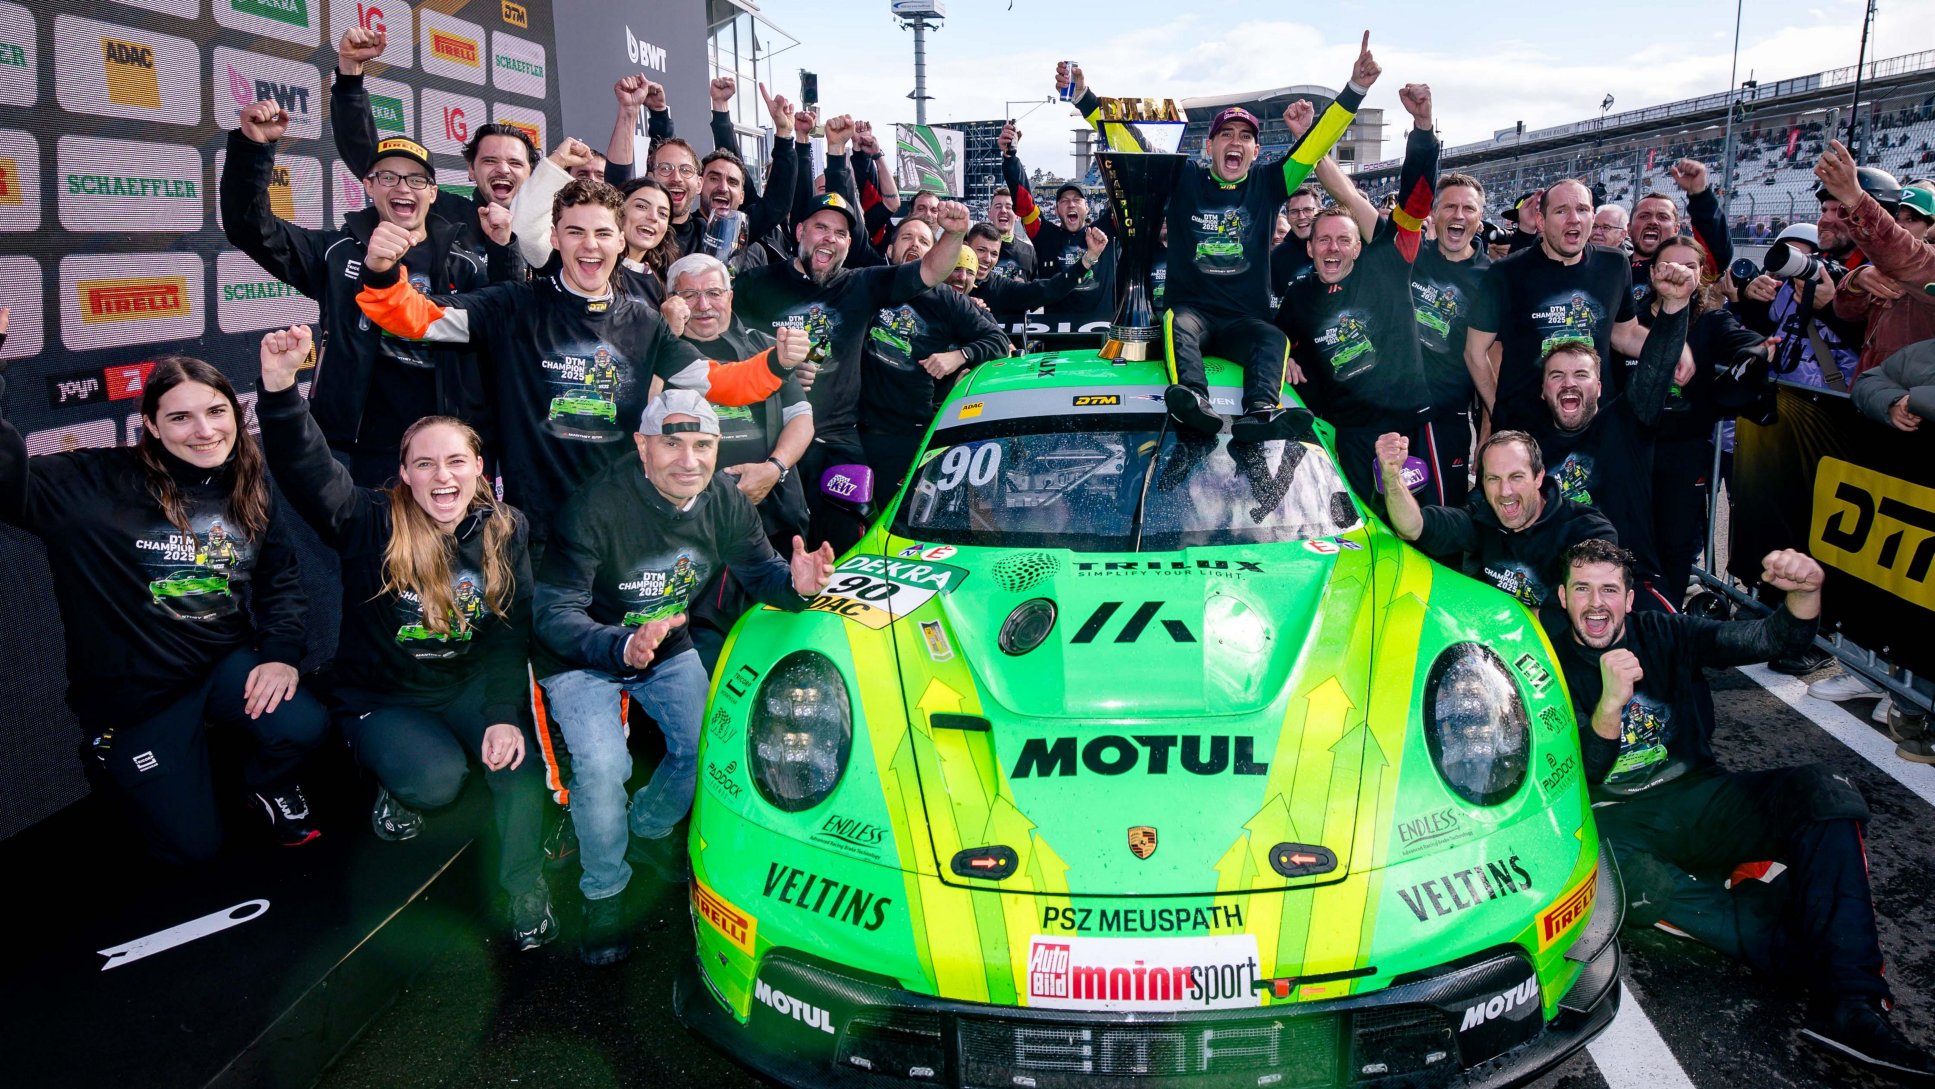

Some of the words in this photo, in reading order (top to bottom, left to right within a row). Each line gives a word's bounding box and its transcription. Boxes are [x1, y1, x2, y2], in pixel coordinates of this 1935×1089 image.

[106, 41, 153, 69] ADAC
[433, 34, 476, 62] PIRELLI
[639, 41, 667, 73] BWT
[496, 54, 543, 79] SCHAEFFLER
[255, 79, 309, 115] BWT
[444, 107, 467, 142] IG
[382, 141, 426, 158] PIRELLI
[67, 174, 198, 199] SCHAEFFLER
[271, 168, 290, 187] AC
[1191, 215, 1219, 225] CHAMPION
[1202, 223, 1219, 231] 2025
[88, 284, 180, 316] PIRELLI
[1547, 316, 1566, 324] 2025
[541, 360, 585, 373] CHAMPION
[565, 356, 586, 366] DTM
[560, 370, 585, 381] 2025
[57, 378, 99, 402] joyn
[1075, 396, 1118, 406] DTM
[1209, 397, 1235, 406] VEN
[962, 402, 983, 411] ADAC
[937, 442, 1001, 491] 90
[135, 539, 195, 553] CHAMPION
[169, 535, 195, 546] DTM
[163, 551, 196, 562] 2025
[1072, 560, 1265, 573] TRILUX
[618, 580, 665, 591] CHAMPION
[643, 572, 666, 581] DTM
[839, 556, 952, 591] DEKRA
[1155, 569, 1192, 577] YOUR
[1200, 570, 1247, 581] LIGHT.
[1484, 567, 1519, 587] CHAMPION
[638, 587, 664, 597] 2025
[828, 576, 901, 601] 90
[1497, 580, 1517, 594] 2025
[809, 595, 871, 616] DAC
[1010, 735, 1270, 779] MOTUL
[706, 762, 743, 799] PADDOCK
[1542, 755, 1576, 793] PADDOCK
[822, 814, 889, 844] ENDLESS
[1398, 808, 1457, 842] ENDLESS
[762, 861, 893, 931] VELTINS
[1397, 855, 1533, 922] VELTINS
[691, 882, 748, 946] PIRELLI
[1544, 868, 1597, 942] PIRELLI
[1043, 905, 1091, 931] PSZ
[1099, 904, 1244, 932] MEUSPATH
[1032, 944, 1069, 973] Auto
[1033, 973, 1067, 998] Bild
[754, 978, 836, 1034] MOTUL
[1459, 973, 1540, 1032] MOTUL
